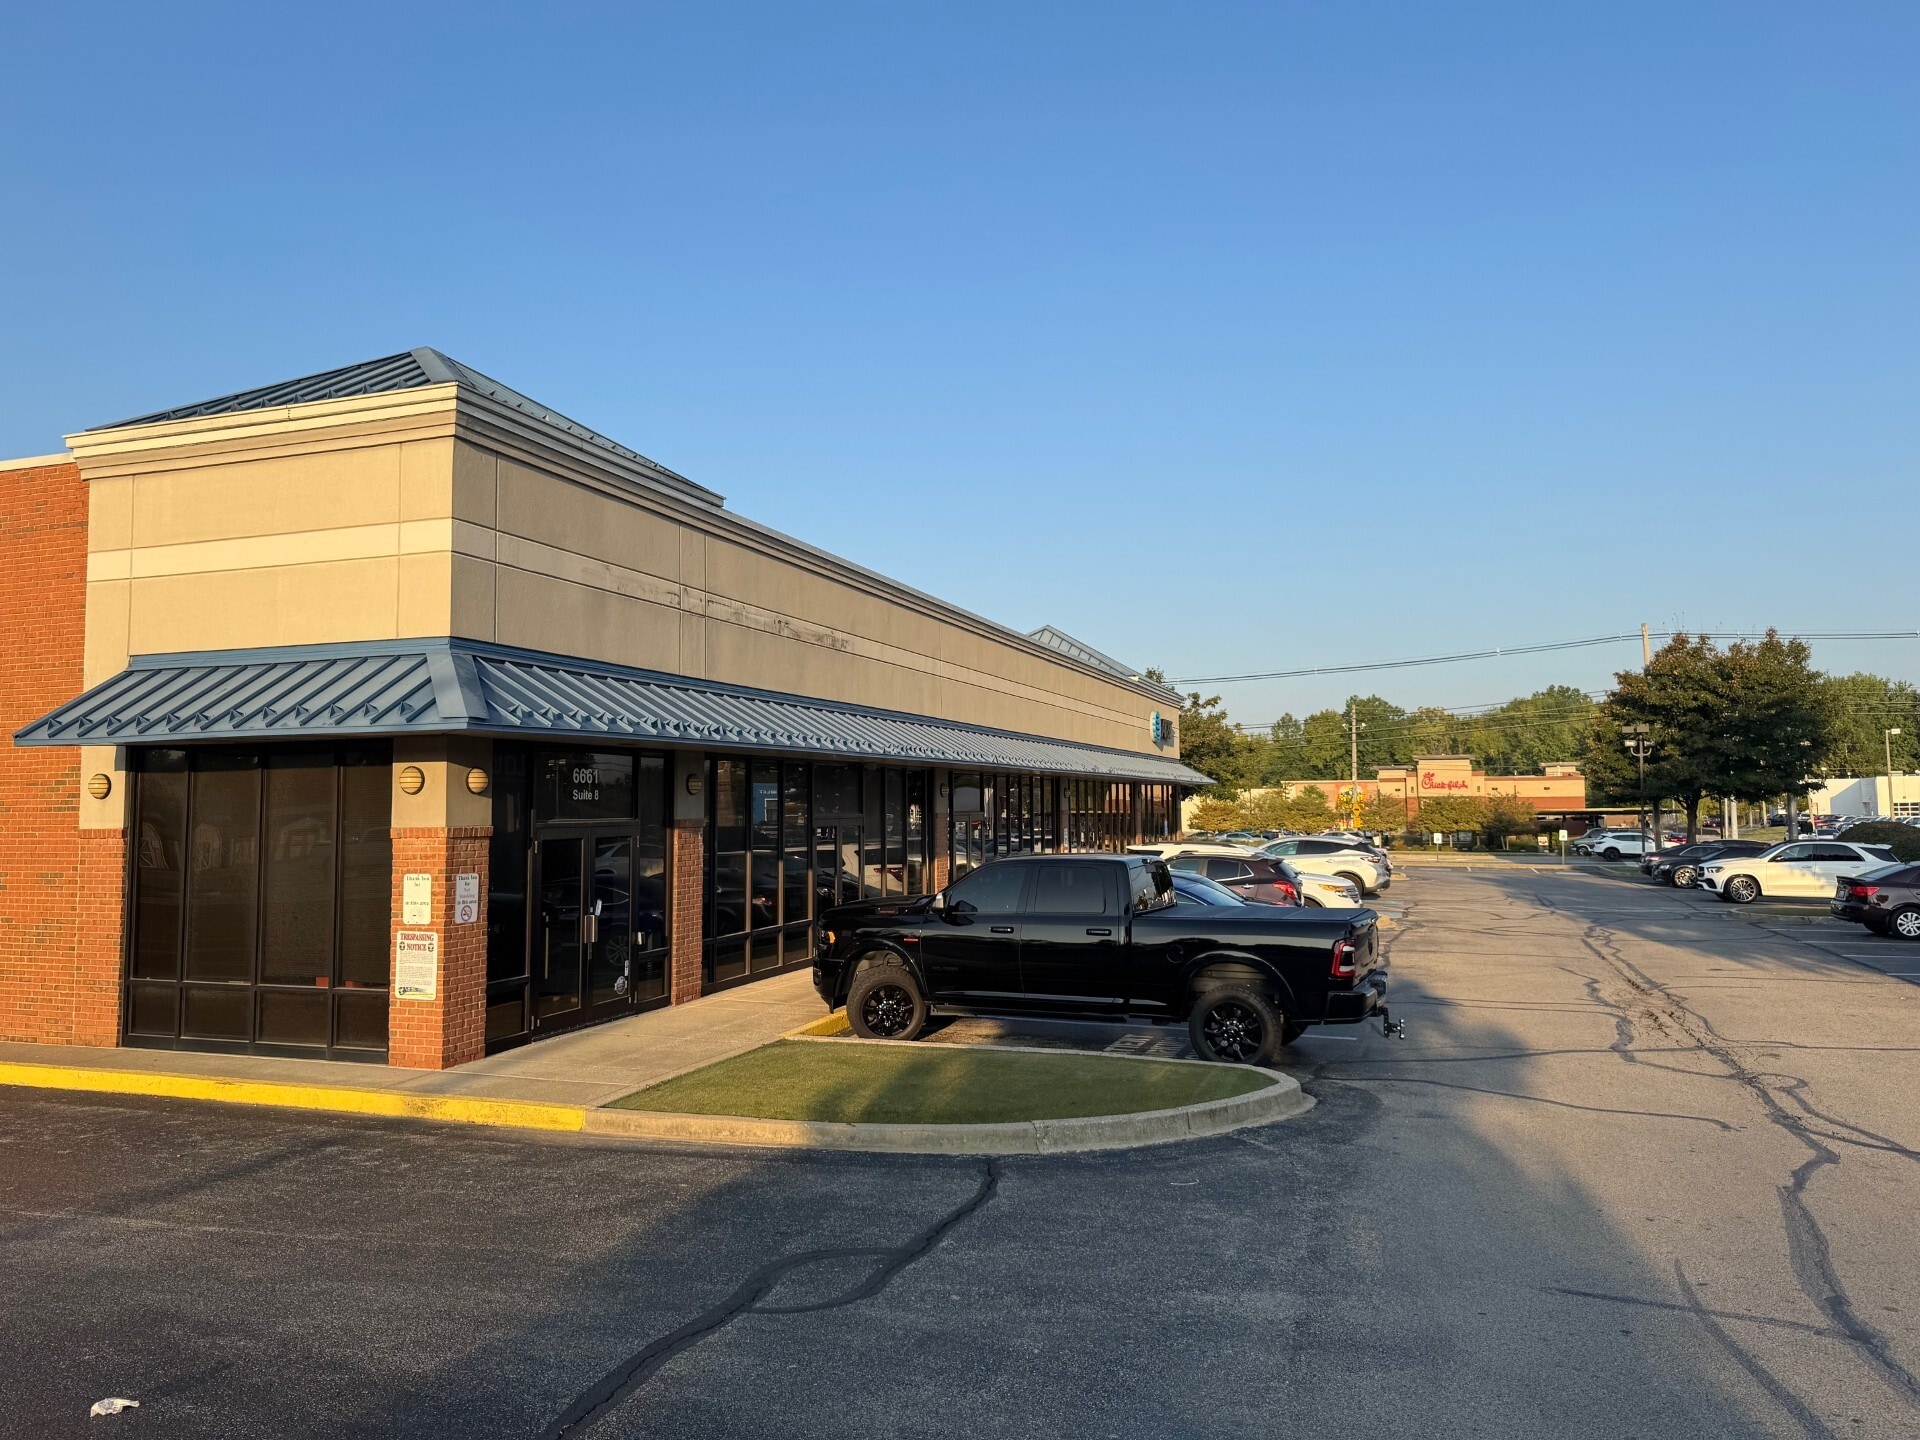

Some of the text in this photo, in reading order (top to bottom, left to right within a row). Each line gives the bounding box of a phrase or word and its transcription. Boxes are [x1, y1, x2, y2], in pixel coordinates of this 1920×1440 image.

[573, 768, 598, 784] 6661
[573, 789, 599, 800] Suite 8
[400, 932, 434, 942] TRESPASSING
[406, 943, 427, 951] NOTICE
